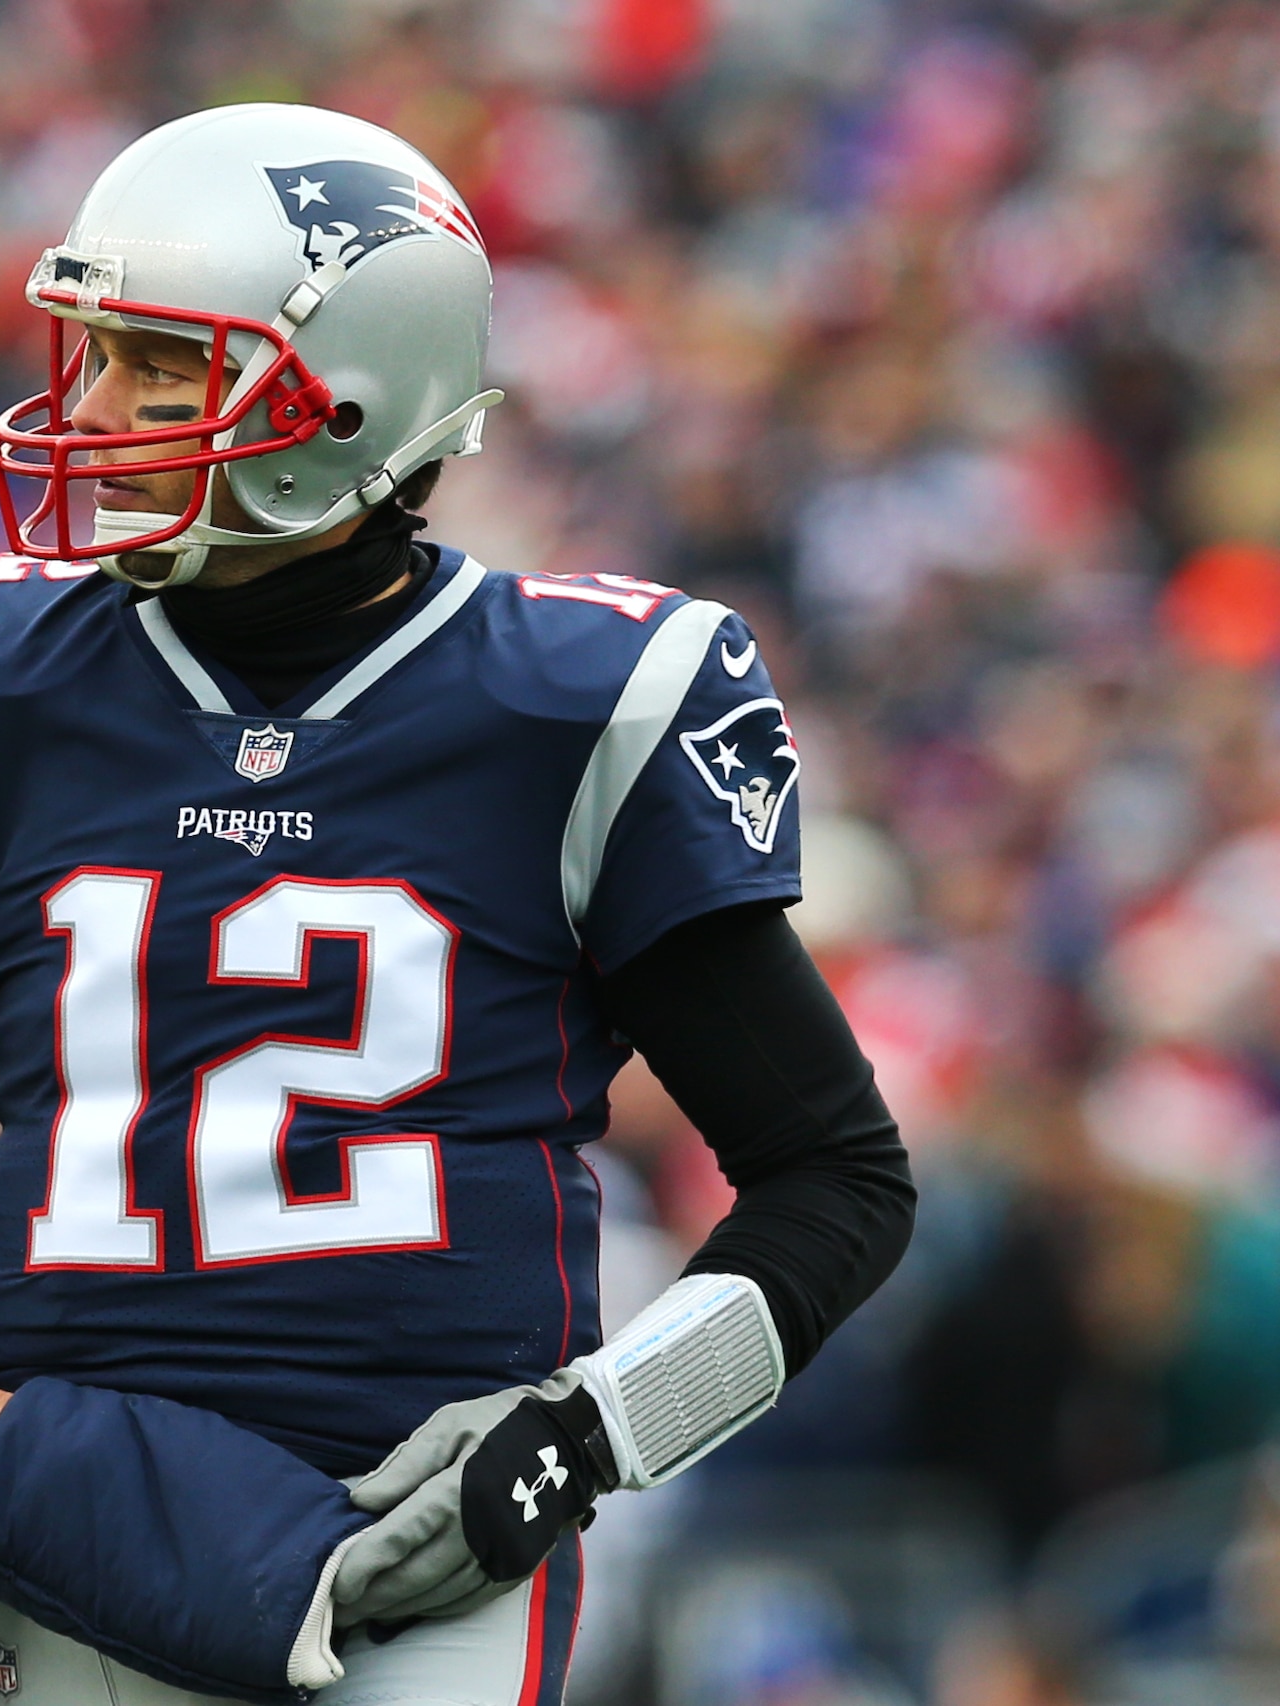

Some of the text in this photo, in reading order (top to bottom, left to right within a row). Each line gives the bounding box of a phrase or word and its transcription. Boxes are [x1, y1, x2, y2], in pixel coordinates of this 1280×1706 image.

[244, 750, 280, 772] NFL
[177, 807, 314, 841] PATRIOTS
[24, 865, 462, 1273] 12
